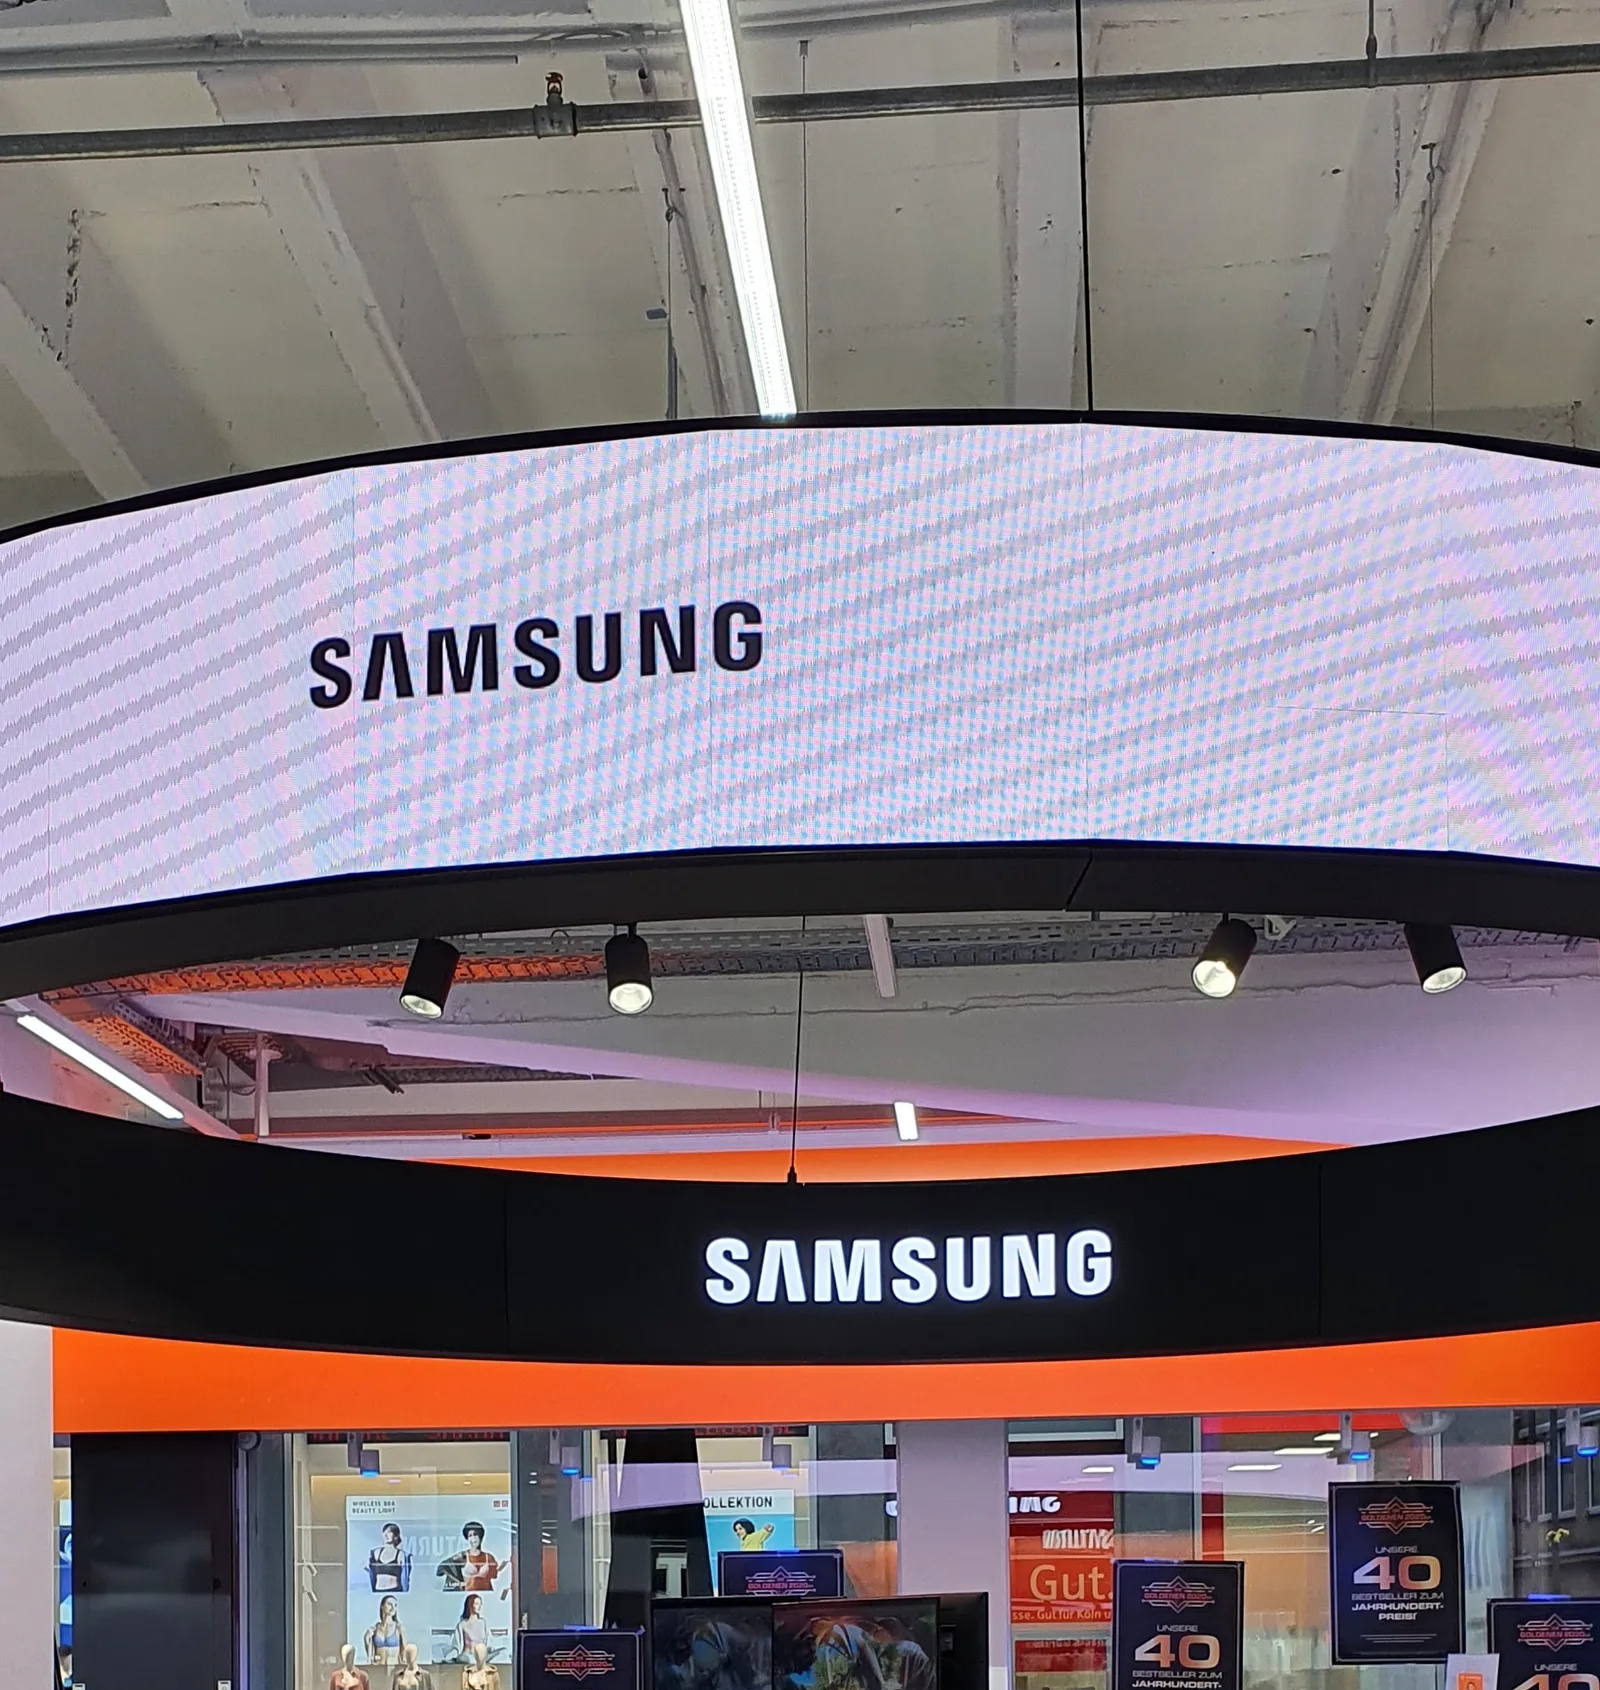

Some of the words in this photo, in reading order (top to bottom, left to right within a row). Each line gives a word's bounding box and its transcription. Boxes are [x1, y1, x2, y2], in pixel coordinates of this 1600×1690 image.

[308, 600, 764, 710] SAMSUNG
[704, 1228, 1113, 1304] SAMSUNG
[704, 1496, 773, 1509] OLLEKTION
[1375, 1545, 1418, 1554] UNSERE
[1353, 1555, 1442, 1590] 40
[1029, 1564, 1114, 1601] Gut.
[1351, 1592, 1418, 1601] BESTSELLER
[1419, 1592, 1445, 1600] ZUM
[1351, 1602, 1444, 1611] JAHRHUNDERT-
[1036, 1609, 1057, 1620] Gut
[1077, 1606, 1101, 1620] Köln
[1156, 1624, 1198, 1632] UNSERE
[1134, 1634, 1221, 1669] 40
[1534, 1663, 1578, 1671] UNSERE
[1132, 1670, 1197, 1678] BESTSELLER
[1198, 1671, 1223, 1679] ZUM
[1132, 1680, 1223, 1689] JAHRHUNDERT-
